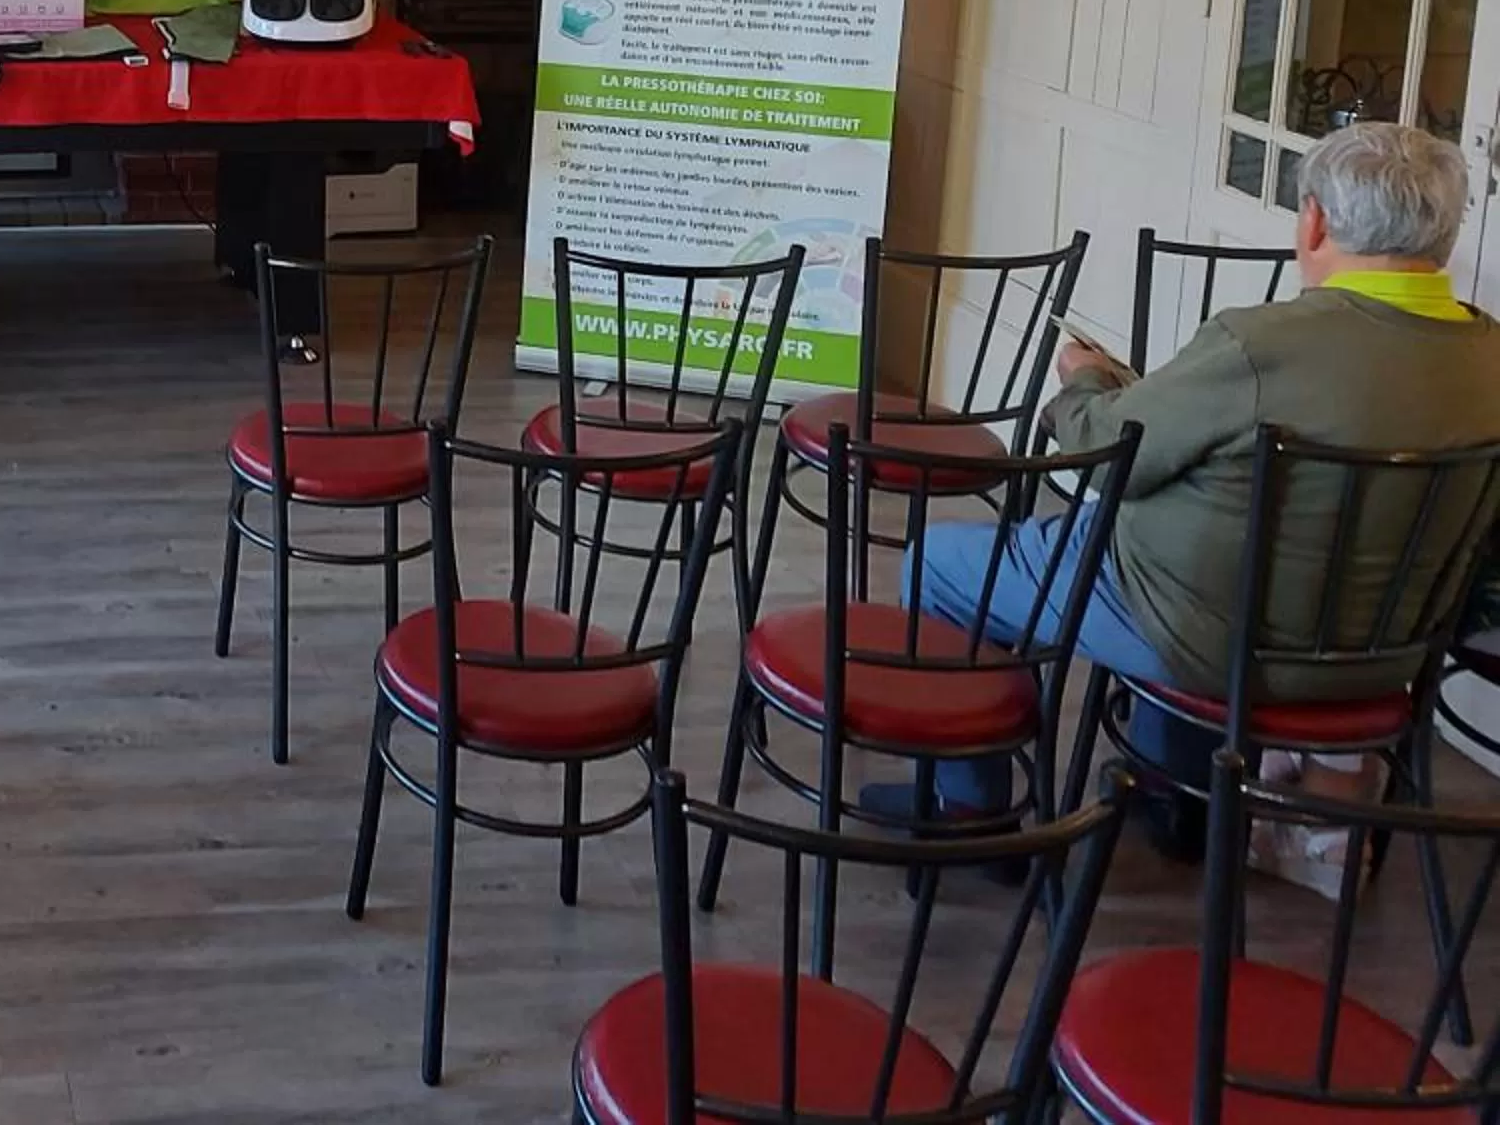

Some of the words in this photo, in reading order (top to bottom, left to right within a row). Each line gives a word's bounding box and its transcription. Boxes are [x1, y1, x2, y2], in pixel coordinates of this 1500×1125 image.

[601, 74, 619, 87] LA
[623, 76, 749, 98] PRESSOTHÉRAPIE
[753, 87, 791, 102] CHEZ
[795, 90, 826, 105] SOI:
[564, 93, 593, 108] UNE
[596, 96, 646, 112] RÉELLE
[650, 101, 739, 121] AUTONOMIE
[743, 109, 763, 122] DE
[765, 110, 861, 132] TRAITEMENT
[557, 119, 641, 138] L'IMPORTANCE
[645, 130, 663, 140] DU
[725, 136, 811, 153] LYMPHATIQUE
[575, 315, 813, 360] WWW.PHYSAROFR
